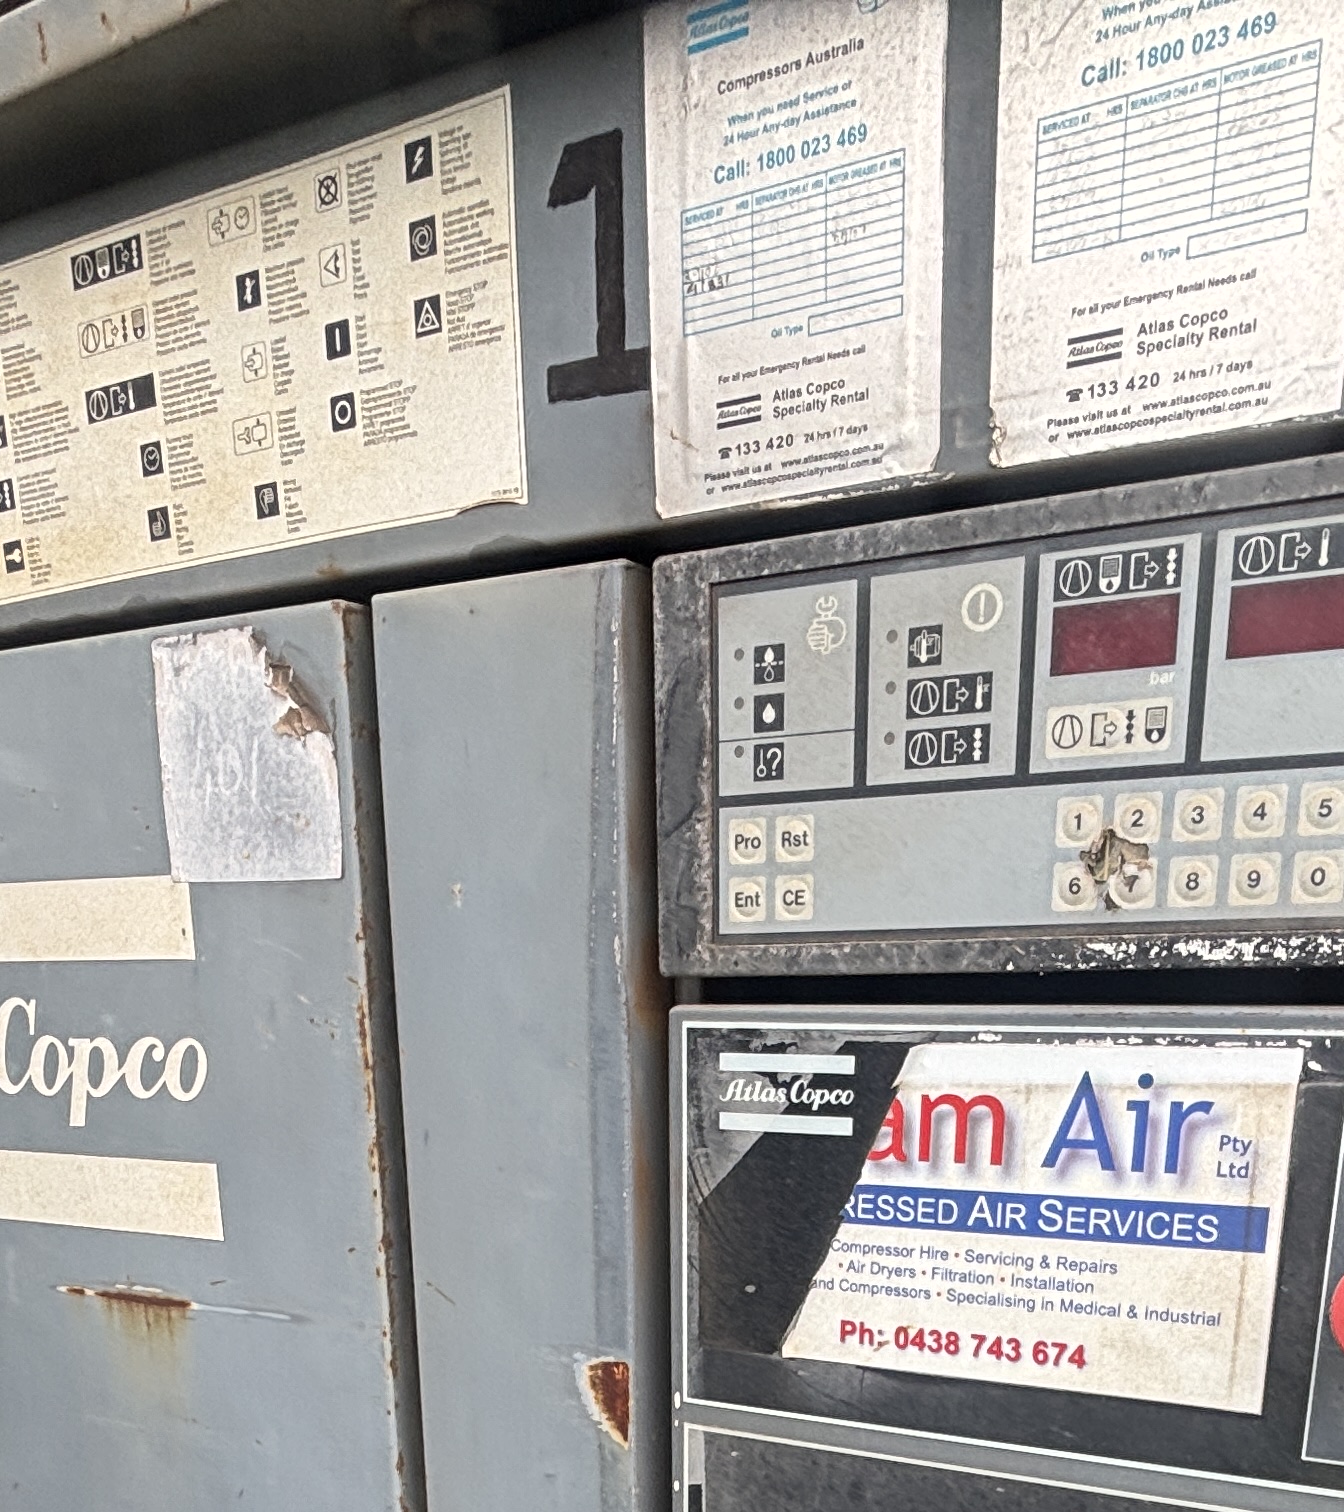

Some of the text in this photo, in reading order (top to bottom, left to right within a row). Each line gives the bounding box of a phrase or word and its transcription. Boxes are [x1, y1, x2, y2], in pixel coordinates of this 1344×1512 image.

[1081, 11, 1278, 88] Call: 1800 023 469
[717, 37, 865, 96] Compressors Australia
[714, 123, 868, 184] Call: 1800 023 469
[547, 127, 650, 404] 1
[1071, 306, 1087, 319] For
[1123, 288, 1174, 308] Emergency
[1136, 308, 1229, 338] Atlas Copco
[1067, 338, 1123, 358] Atlas Copco
[1136, 318, 1258, 357] Specialty Rental
[772, 377, 846, 403] Atlas Copco
[1087, 380, 1119, 400] 133
[1125, 372, 1161, 393] 420
[1172, 370, 1187, 383] 24
[1189, 365, 1208, 380] hrs
[1216, 362, 1224, 375] 7
[1226, 359, 1254, 376] days
[772, 387, 869, 420] Specialty Rental
[1047, 415, 1080, 430] Please
[1106, 408, 1119, 418] us
[1121, 404, 1132, 417] at
[1142, 379, 1272, 412] www.atlascopco.com.au
[734, 441, 761, 457] 133
[765, 433, 794, 451] 420
[803, 431, 815, 444] 24
[846, 423, 869, 437] days
[1148, 670, 1175, 686] bar
[1129, 808, 1145, 828] 2
[1191, 805, 1205, 825] 3
[1252, 802, 1268, 822] 4
[1318, 798, 1333, 818] 5
[1073, 812, 1085, 831] 1
[733, 831, 763, 852] Pro
[780, 828, 810, 850] Rst
[1068, 876, 1082, 896] 6
[1125, 874, 1139, 894] 7
[1185, 872, 1200, 891] 8
[1246, 869, 1261, 889] 9
[1310, 867, 1326, 887] 0
[733, 889, 762, 910] Ent
[781, 888, 806, 909] CE
[719, 1078, 855, 1112] Atlas Copco
[1040, 1070, 1216, 1176] Air
[1219, 1134, 1253, 1160] Pty
[1216, 1157, 1250, 1180] Ltd
[1037, 1198, 1220, 1243] SERVICES
[830, 1238, 1118, 1277] Compressor Hire Servicing & Repairs
[846, 1259, 1095, 1295] Air Dryers Filtration Installation
[838, 1278, 932, 1300] Compressors
[946, 1288, 1036, 1313] Specialising
[1041, 1297, 1055, 1312] in
[1059, 1300, 1122, 1319] Medical
[1126, 1305, 1139, 1320] &
[1144, 1306, 1222, 1328] Industrial
[839, 1319, 1088, 1370] Ph: 0438 743 674
